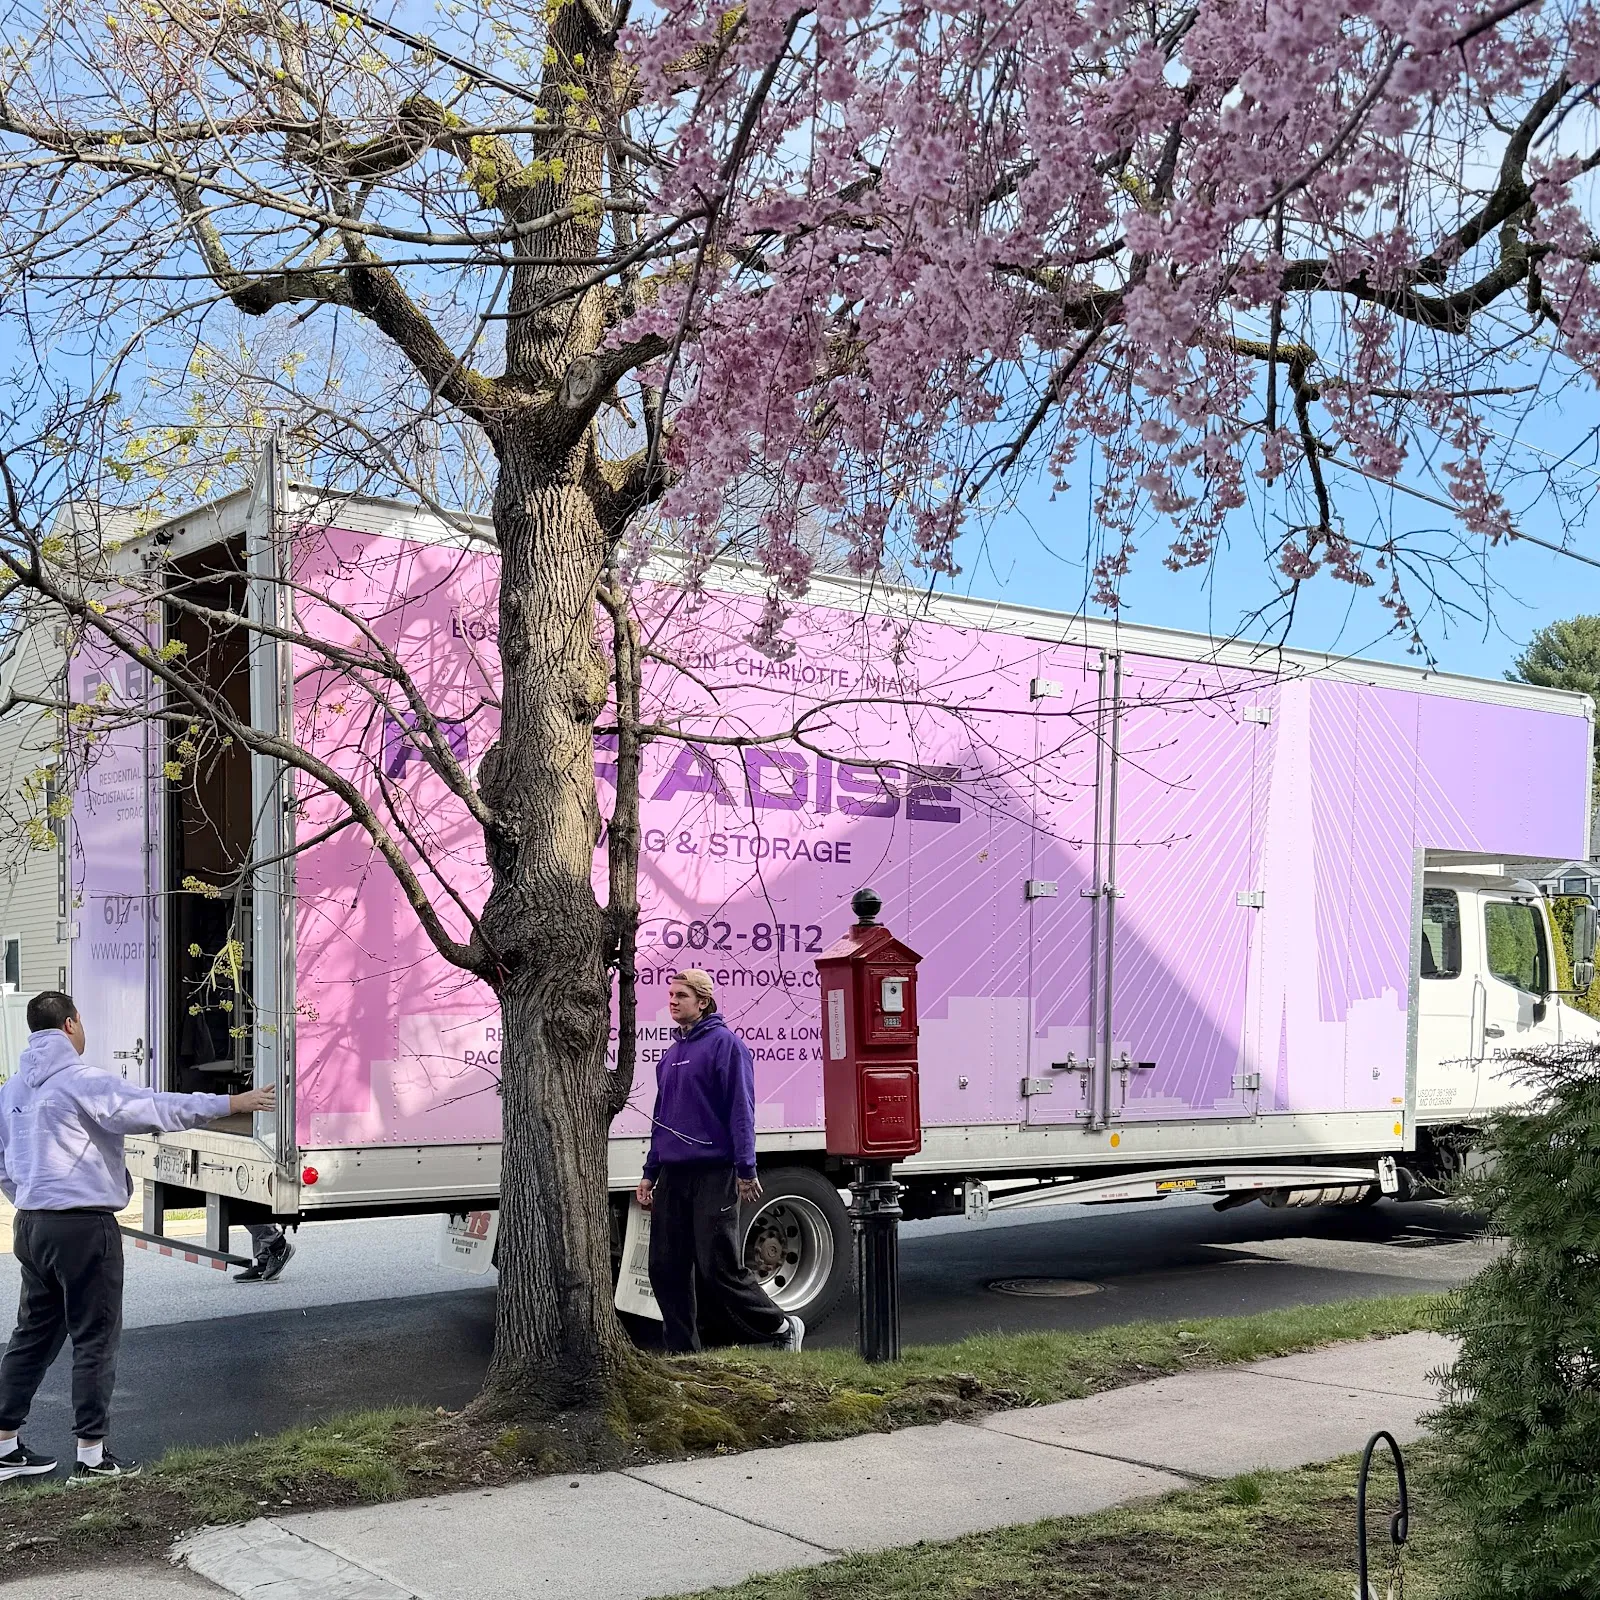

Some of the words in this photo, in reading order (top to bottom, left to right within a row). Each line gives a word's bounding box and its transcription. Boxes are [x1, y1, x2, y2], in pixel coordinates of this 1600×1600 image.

[736, 656, 849, 689] CHARLOTTE
[676, 831, 698, 855] &
[709, 832, 852, 864] STORAGE
[734, 1027, 774, 1041] OCAL
[777, 1027, 787, 1041] &
[798, 1047, 808, 1061] &
